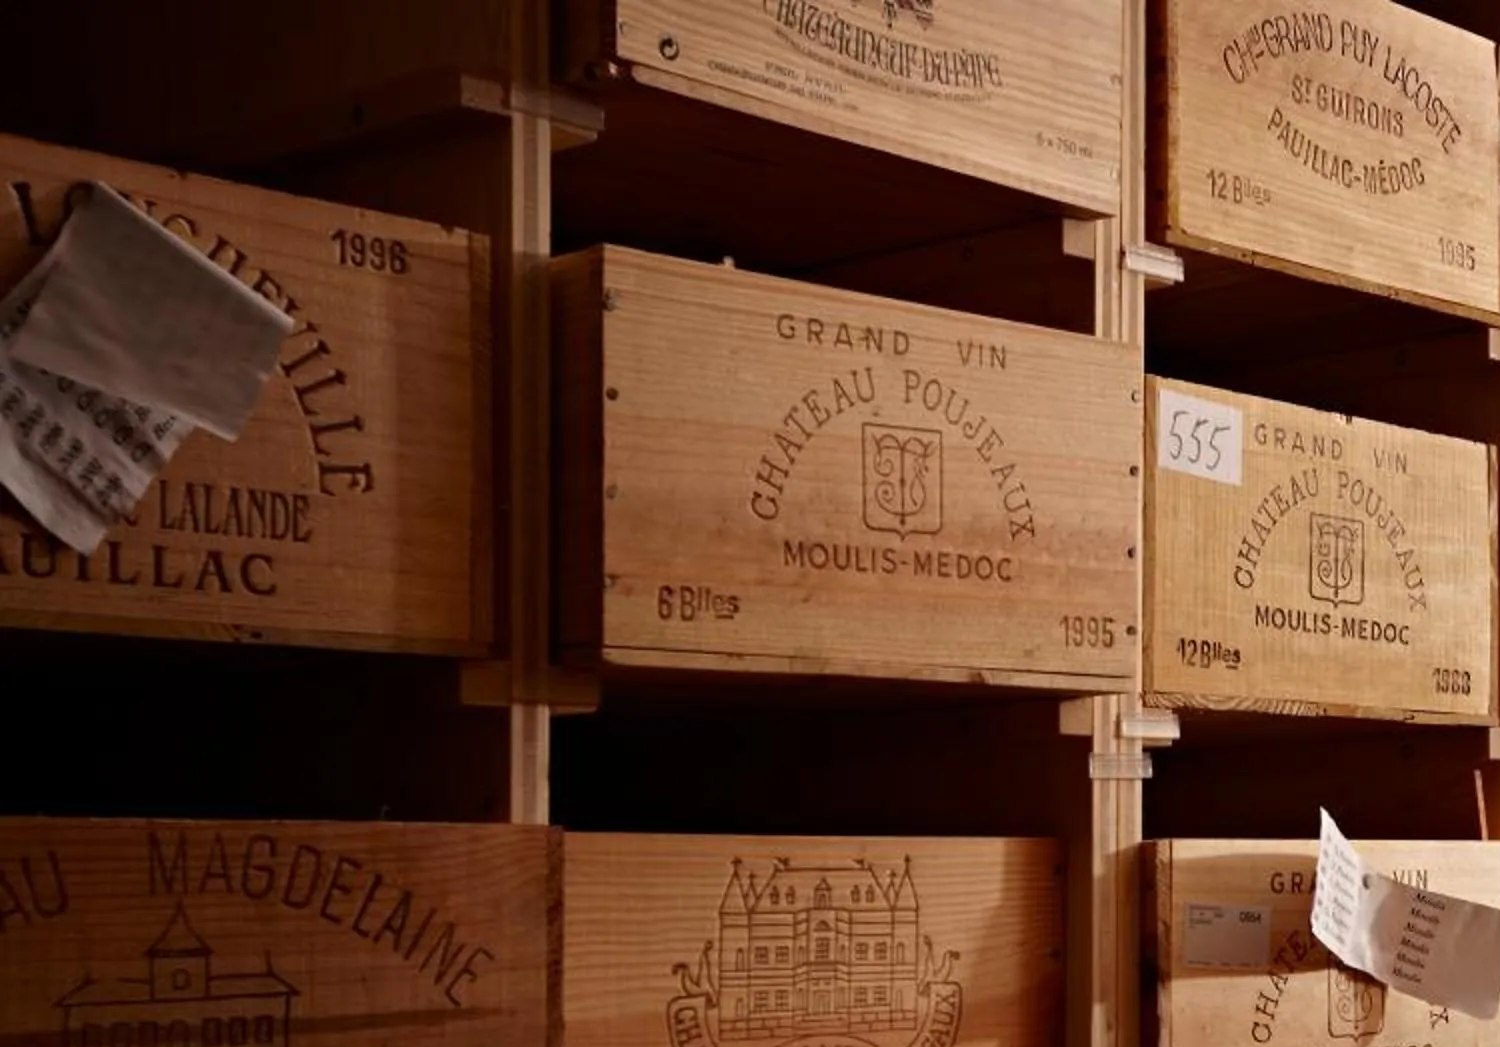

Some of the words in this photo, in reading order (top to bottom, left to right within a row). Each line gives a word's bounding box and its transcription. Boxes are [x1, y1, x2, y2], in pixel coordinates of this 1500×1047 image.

[1262, 12, 1334, 60] GRAND
[1340, 20, 1380, 69] PUY
[1384, 45, 1462, 155] LACOSTE
[330, 228, 411, 275] 1996
[776, 313, 911, 357] GRAND
[957, 338, 1008, 369] VIN
[750, 366, 877, 522] CHATEAU
[902, 368, 1036, 542] POUJEAUX
[1168, 410, 1232, 471] 555
[1254, 424, 1344, 461] GRAND
[1373, 447, 1408, 474] VIN
[158, 478, 313, 544] LALANDE
[782, 539, 1014, 583] MOULIS-MEDOC
[1233, 468, 1321, 590] CHATEAU
[1336, 470, 1428, 613] POUJEAUX
[1059, 614, 1117, 649] 1995
[1254, 604, 1411, 647] MOULIS-MEDOC
[1269, 871, 1318, 895] GRA
[147, 831, 496, 1008] MAGDELAINE
